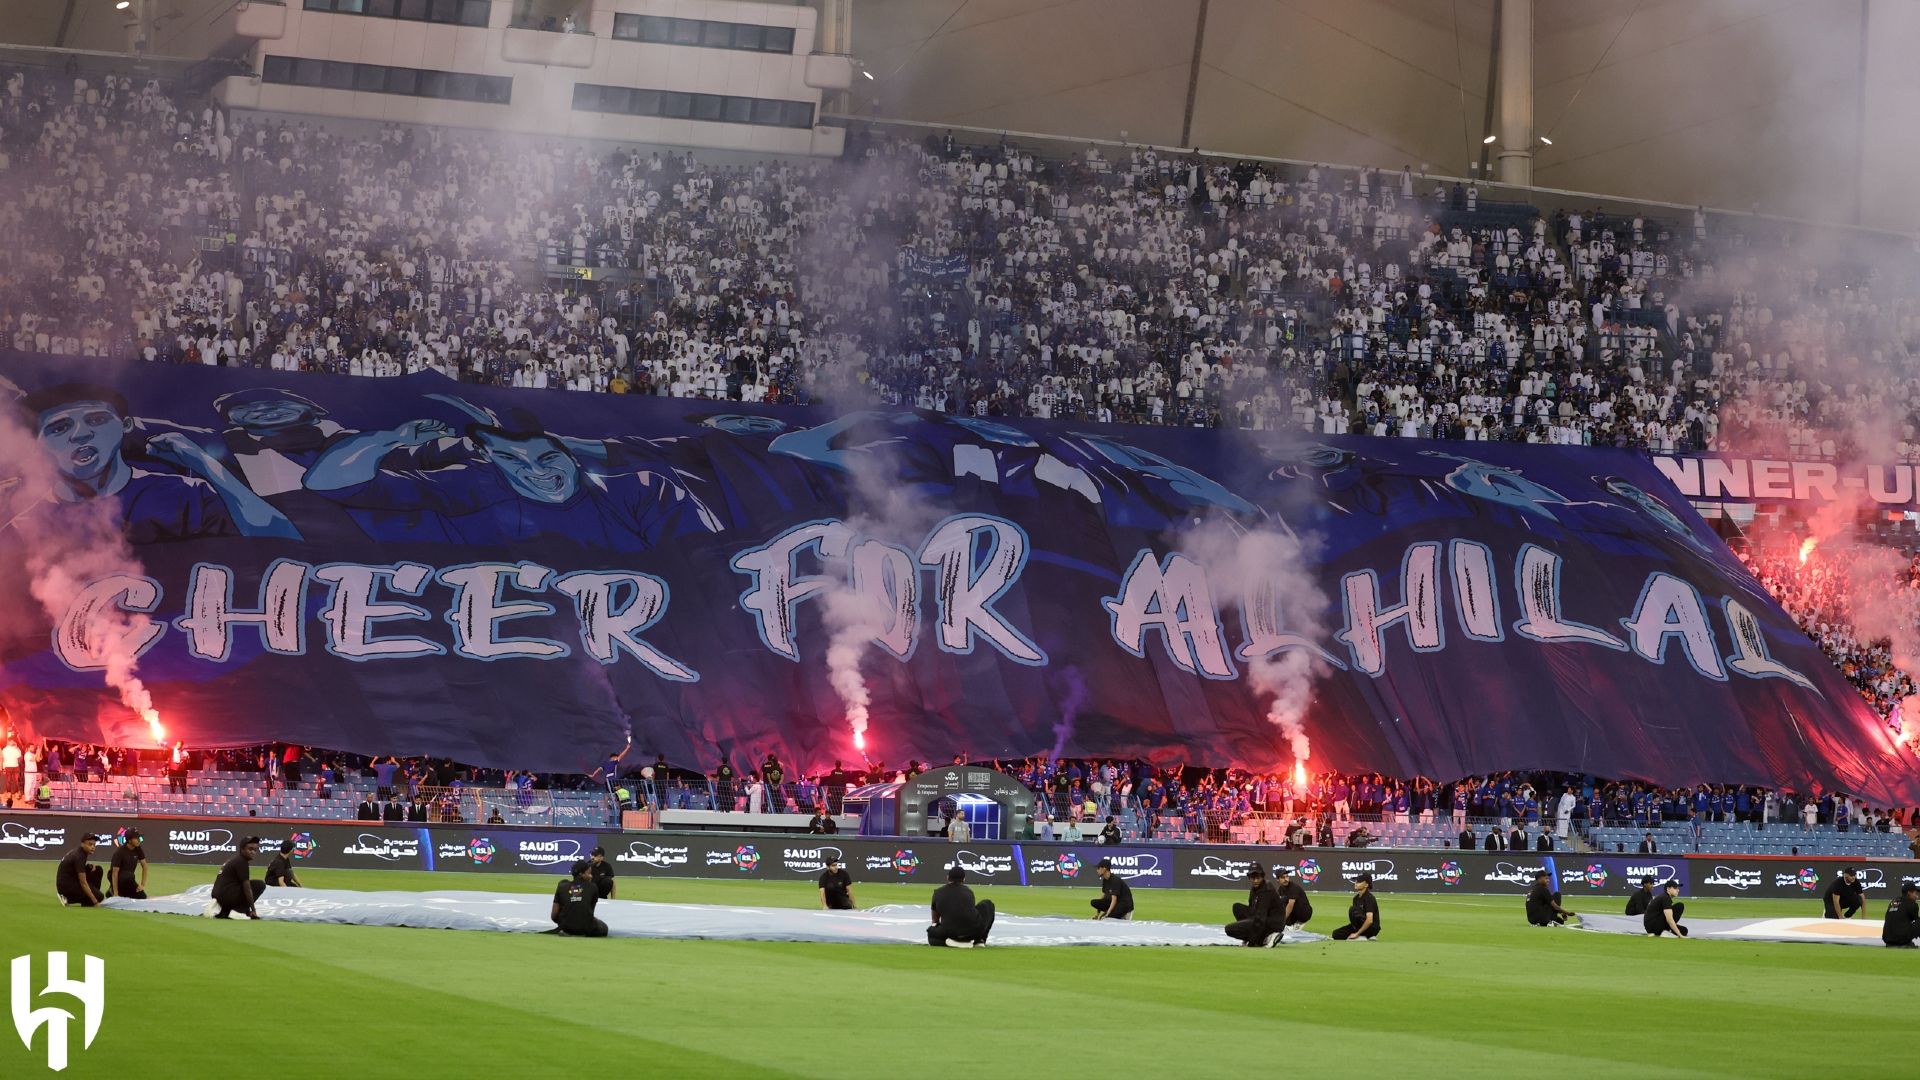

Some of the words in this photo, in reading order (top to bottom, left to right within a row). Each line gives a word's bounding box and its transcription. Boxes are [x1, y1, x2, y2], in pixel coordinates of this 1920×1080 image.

[1652, 456, 1920, 504] NNER-U
[51, 557, 700, 683] CHEER
[729, 512, 1049, 666] FOR
[0, 832, 35, 844] الفض
[169, 831, 210, 841] SAUDI
[343, 844, 390, 855] الفضاء
[520, 841, 558, 852] SAUDI
[391, 846, 418, 858] نحو
[616, 852, 660, 862] الفضاء
[784, 849, 821, 858] SAUDI
[661, 854, 687, 864] نحو
[986, 862, 1011, 873] نحو
[1191, 866, 1232, 875] الفضاء
[1342, 862, 1375, 870] SAUDI
[1485, 871, 1522, 880] الفضاء
[1626, 867, 1658, 876] SAUDI
[1837, 870, 1866, 880] SDI
[1704, 876, 1739, 884] الفضاء
[1741, 877, 1761, 886] نحو
